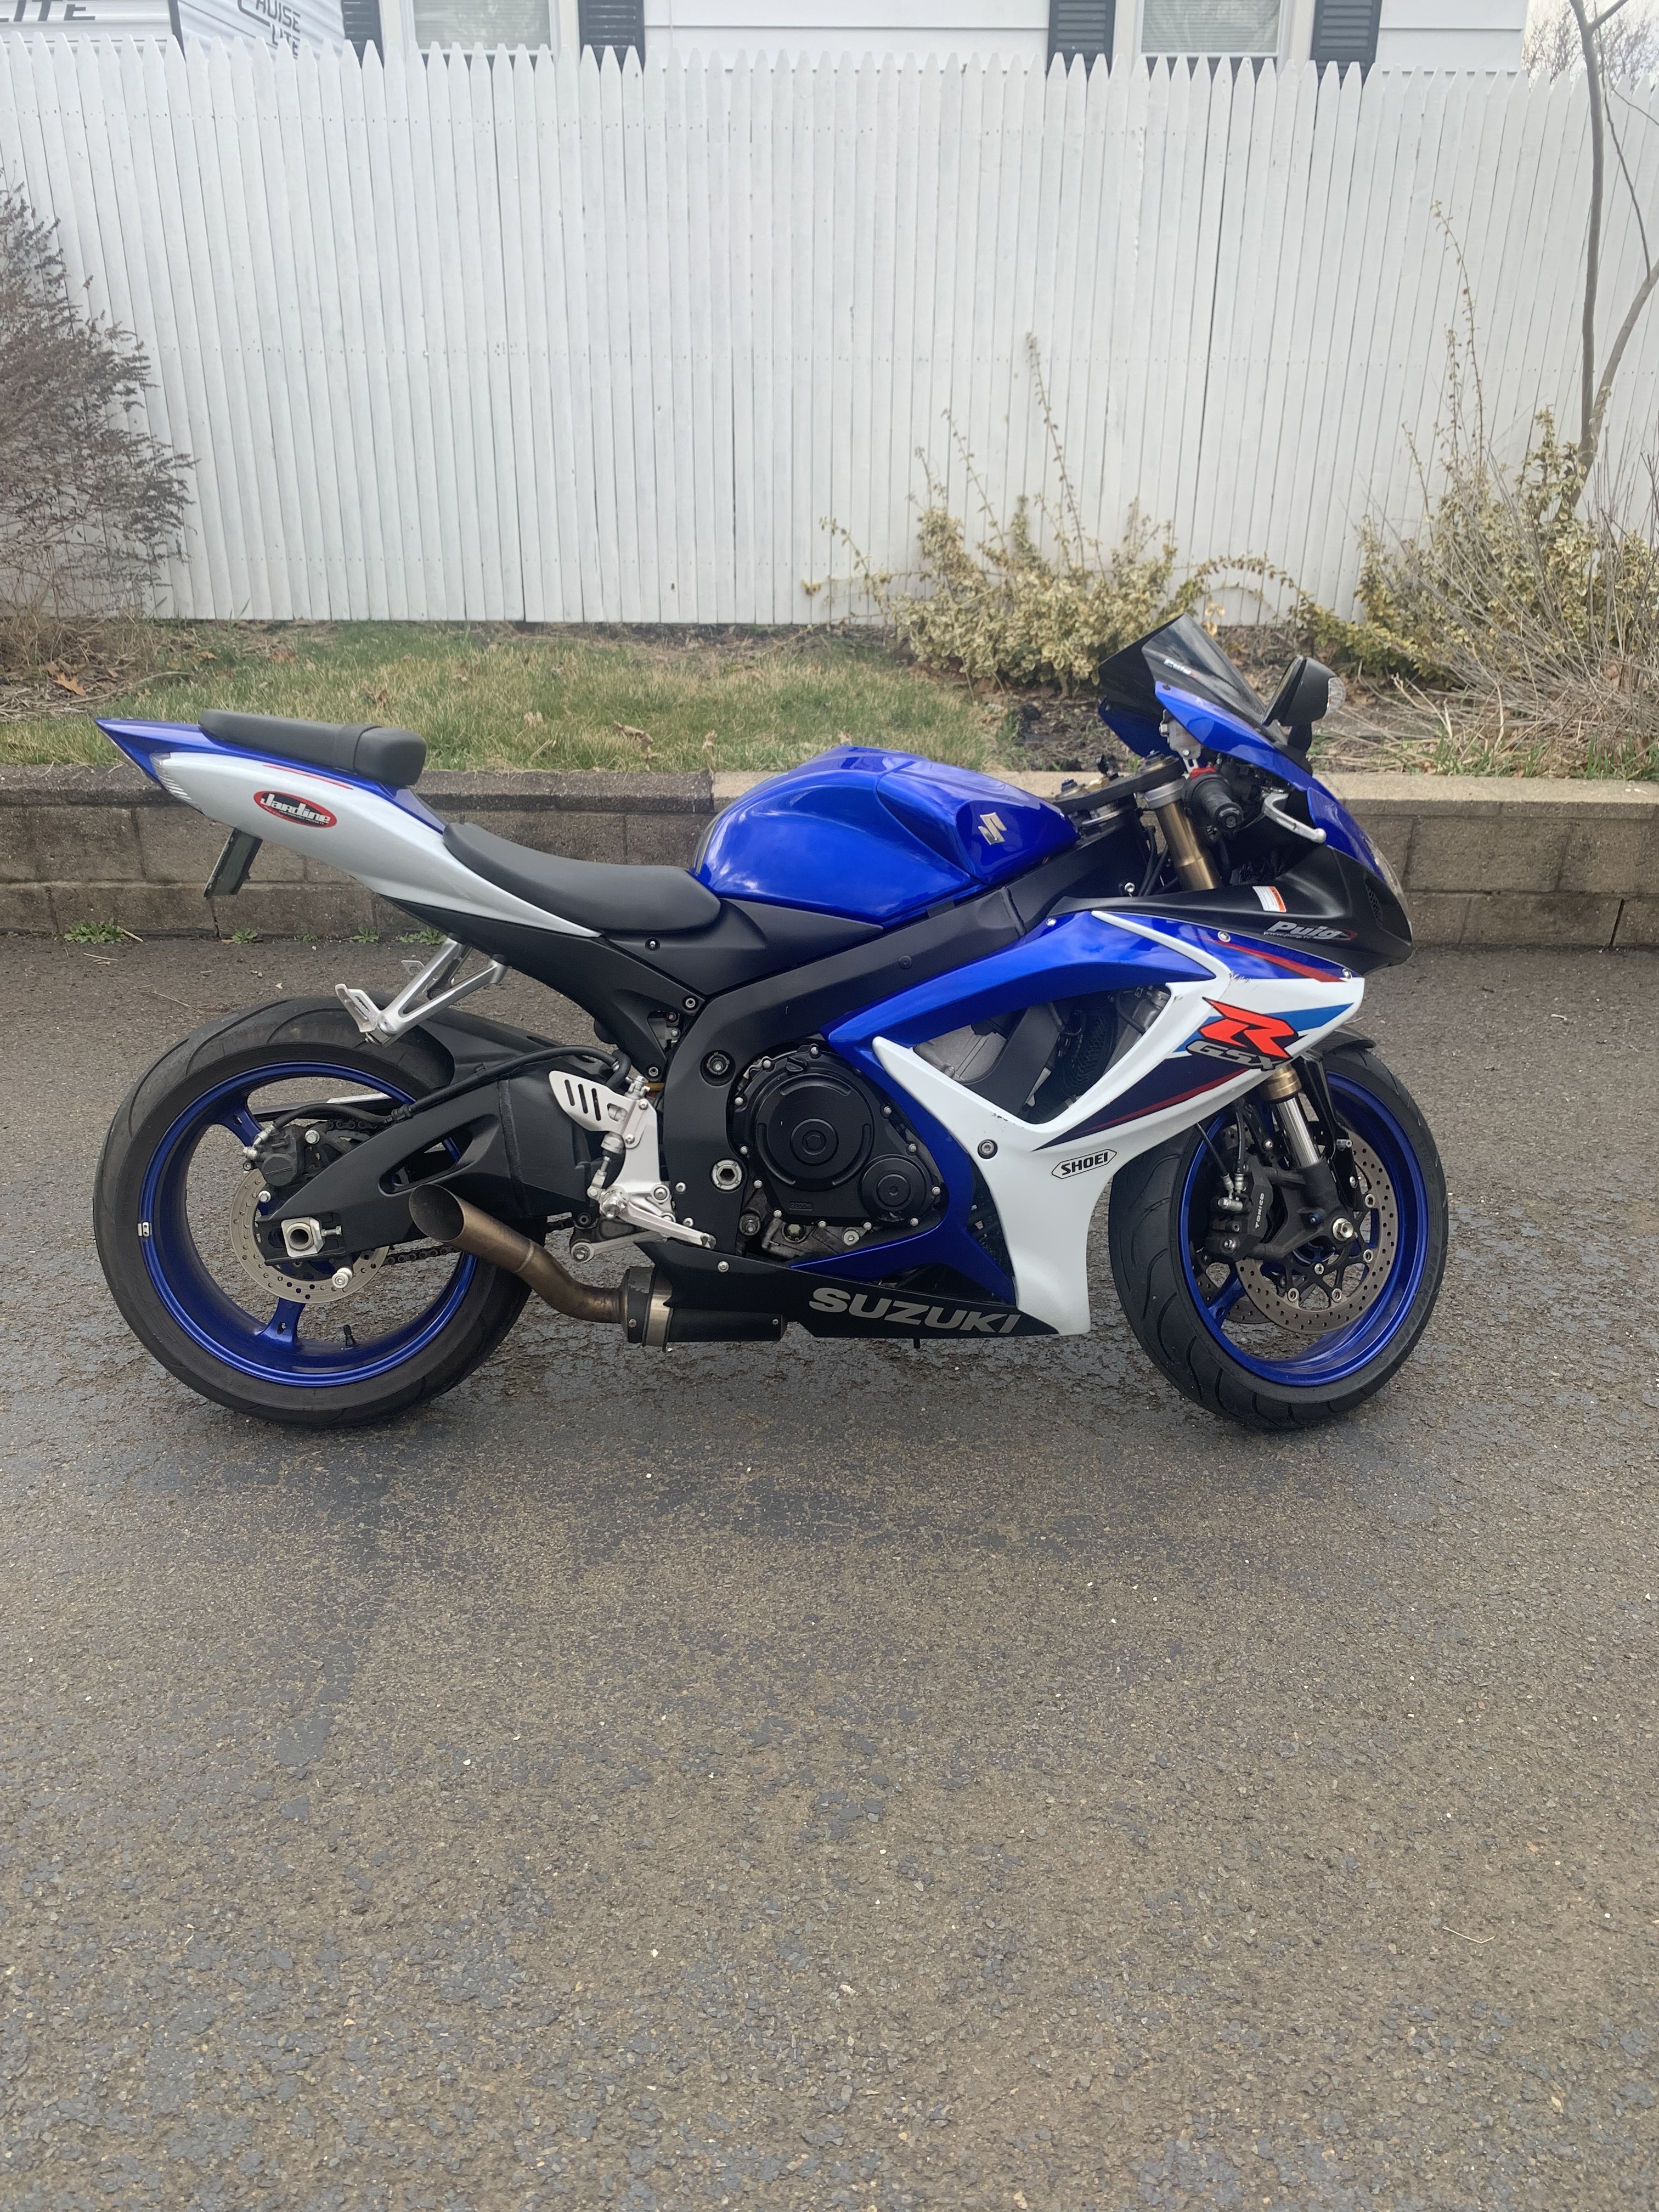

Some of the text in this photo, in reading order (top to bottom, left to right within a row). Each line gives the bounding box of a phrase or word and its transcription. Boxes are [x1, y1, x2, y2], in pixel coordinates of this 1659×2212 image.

[1267, 921, 1342, 940] Puig
[1060, 1152, 1108, 1176] SHOEI
[1255, 1193, 1265, 1229] TOKICO
[809, 1287, 1022, 1334] SUZUKI
[1394, 1243, 1439, 1352] MICHELIN
